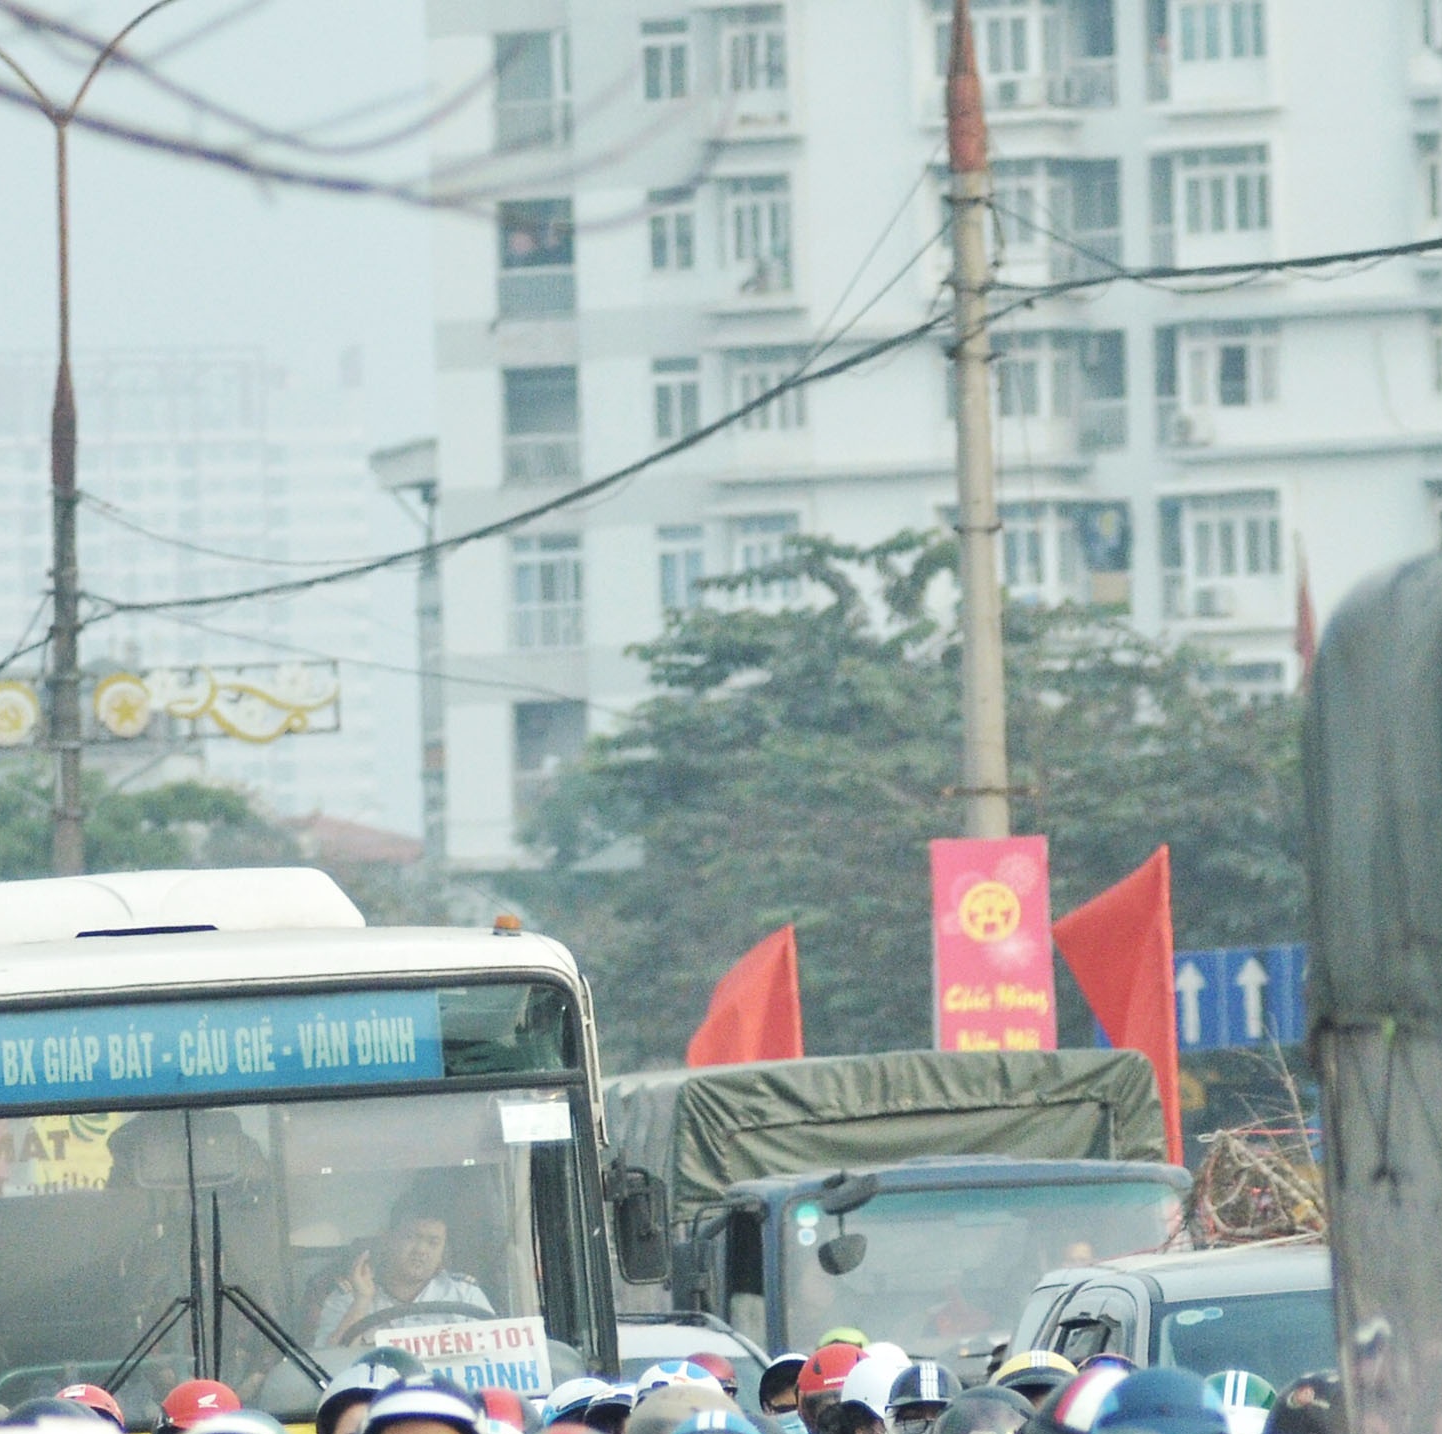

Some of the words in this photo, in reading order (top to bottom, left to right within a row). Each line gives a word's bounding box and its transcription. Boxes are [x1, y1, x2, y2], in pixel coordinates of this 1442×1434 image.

[2, 1038, 37, 1086] BX
[43, 1026, 100, 1084] GIÁP
[108, 1023, 155, 1080] BÁT
[298, 1012, 350, 1069] VÂN
[355, 1009, 416, 1066] ĐÌNH
[491, 1326, 535, 1350] 101
[464, 1358, 540, 1391] ĐÌNH
